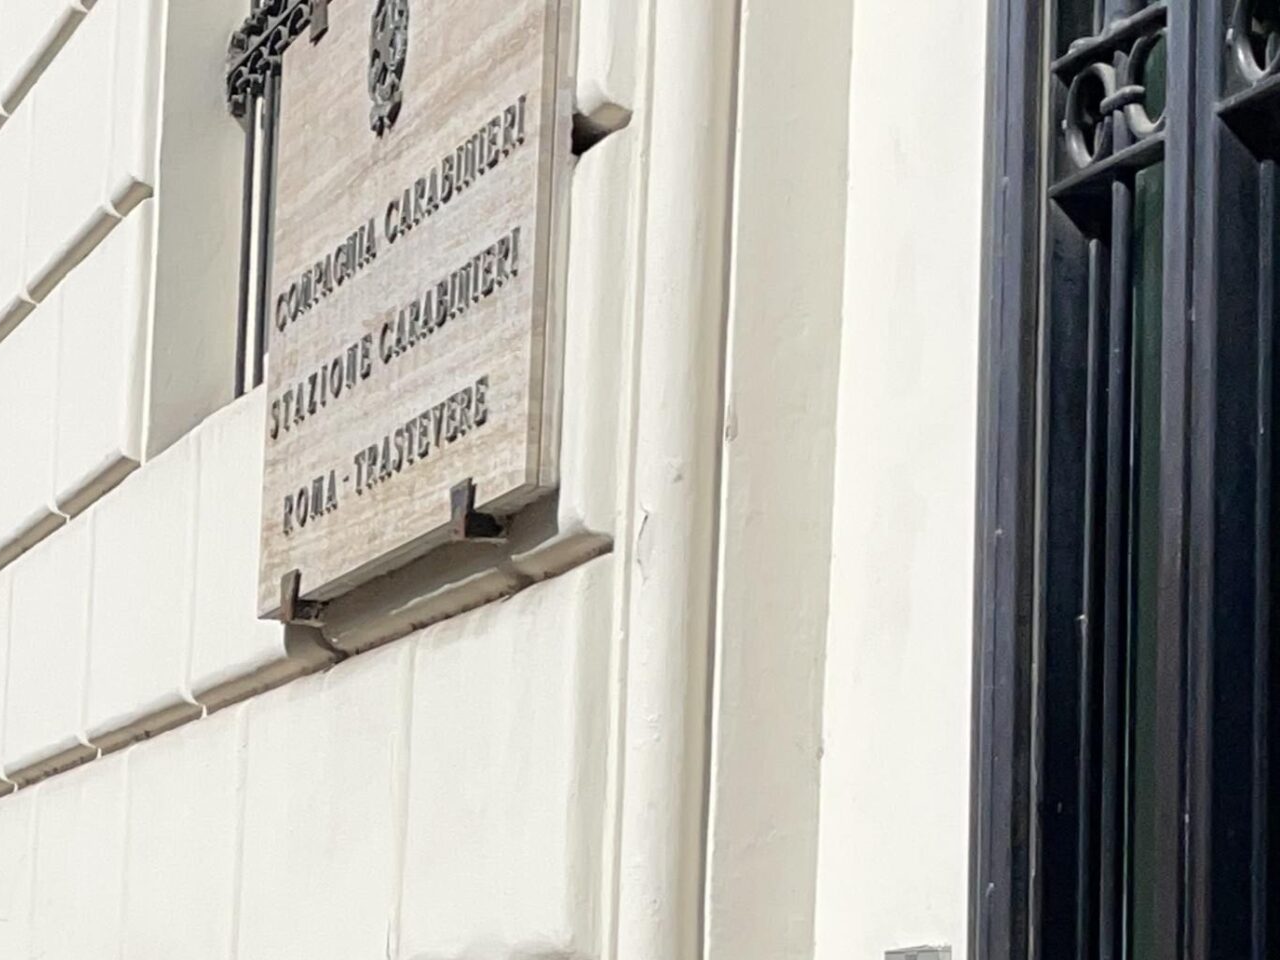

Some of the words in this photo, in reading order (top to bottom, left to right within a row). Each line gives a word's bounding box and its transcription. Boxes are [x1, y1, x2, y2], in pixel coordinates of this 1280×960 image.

[276, 217, 375, 332] COMPAGNIA
[385, 95, 526, 244] CARABINIERI
[270, 333, 372, 440] STAZIONE
[379, 227, 520, 364] CARABINIERI
[283, 469, 338, 536] ROMA
[354, 374, 489, 496] TRASTEVERE
